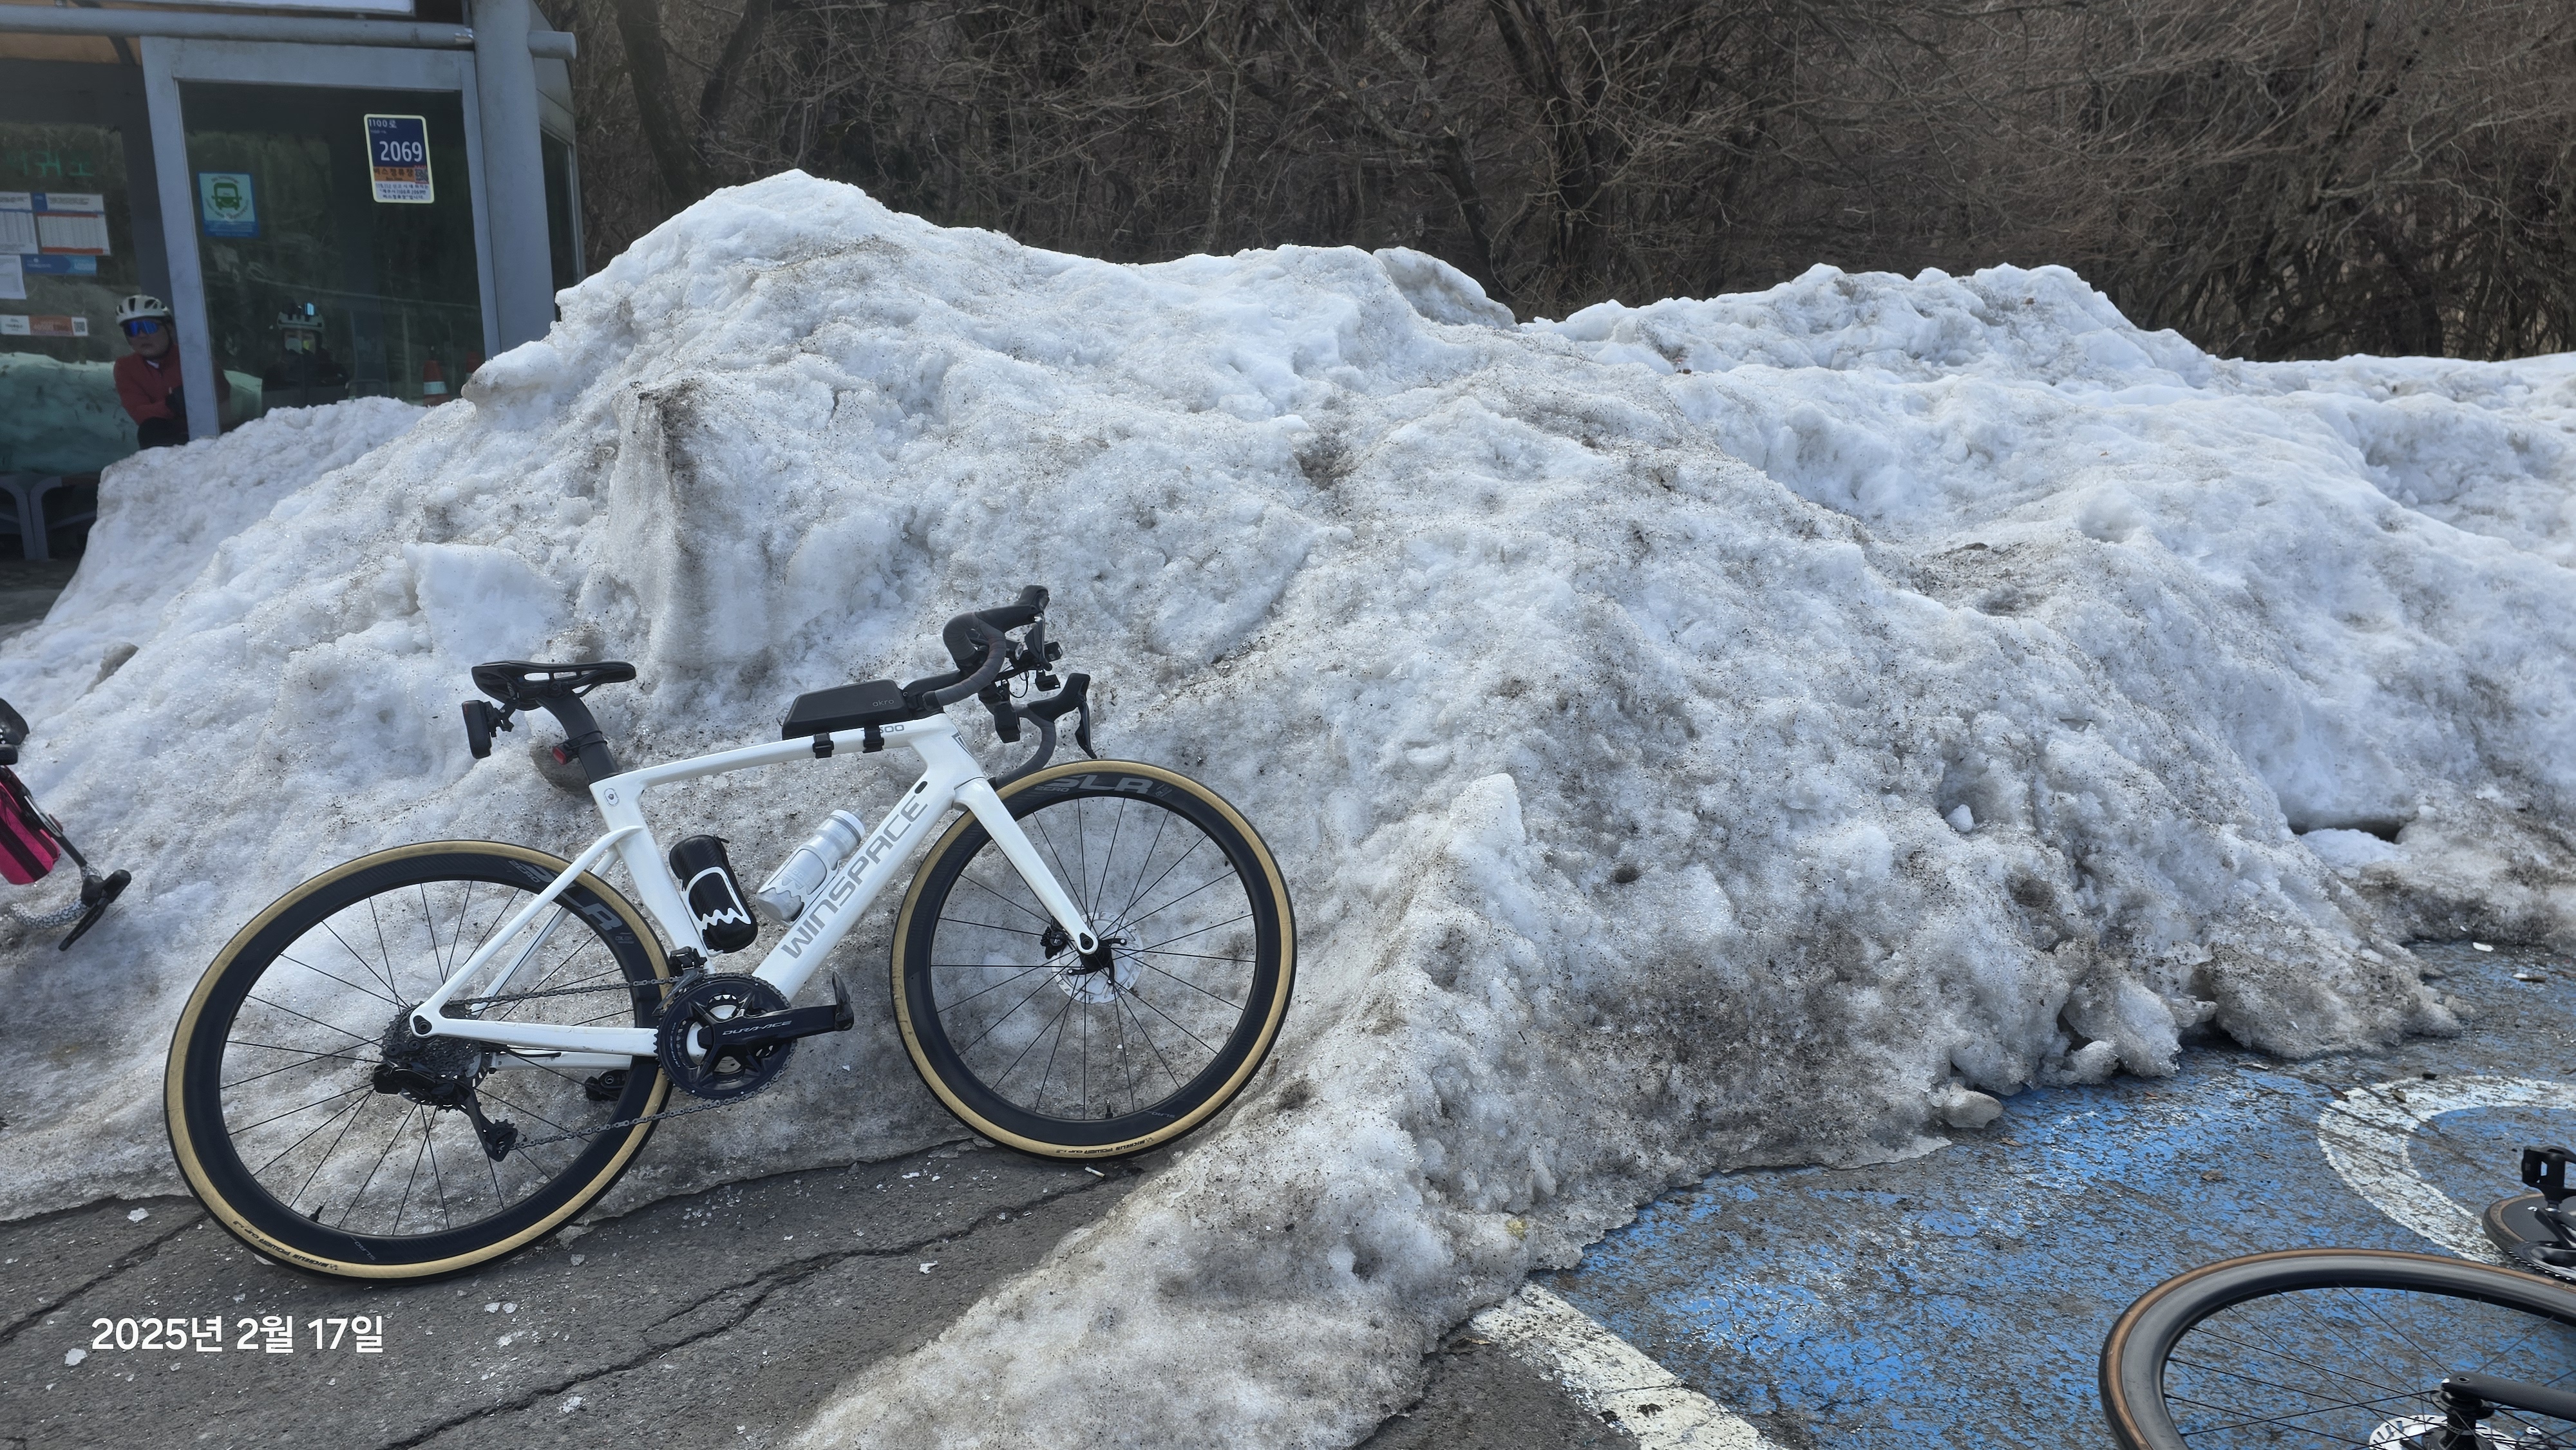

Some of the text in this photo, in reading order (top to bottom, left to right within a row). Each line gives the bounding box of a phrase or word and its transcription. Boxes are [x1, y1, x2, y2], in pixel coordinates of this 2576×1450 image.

[379, 140, 422, 162] 2069
[1043, 775, 1153, 794] SLR
[507, 860, 541, 883] ZERO
[781, 795, 928, 959] WINSPACE
